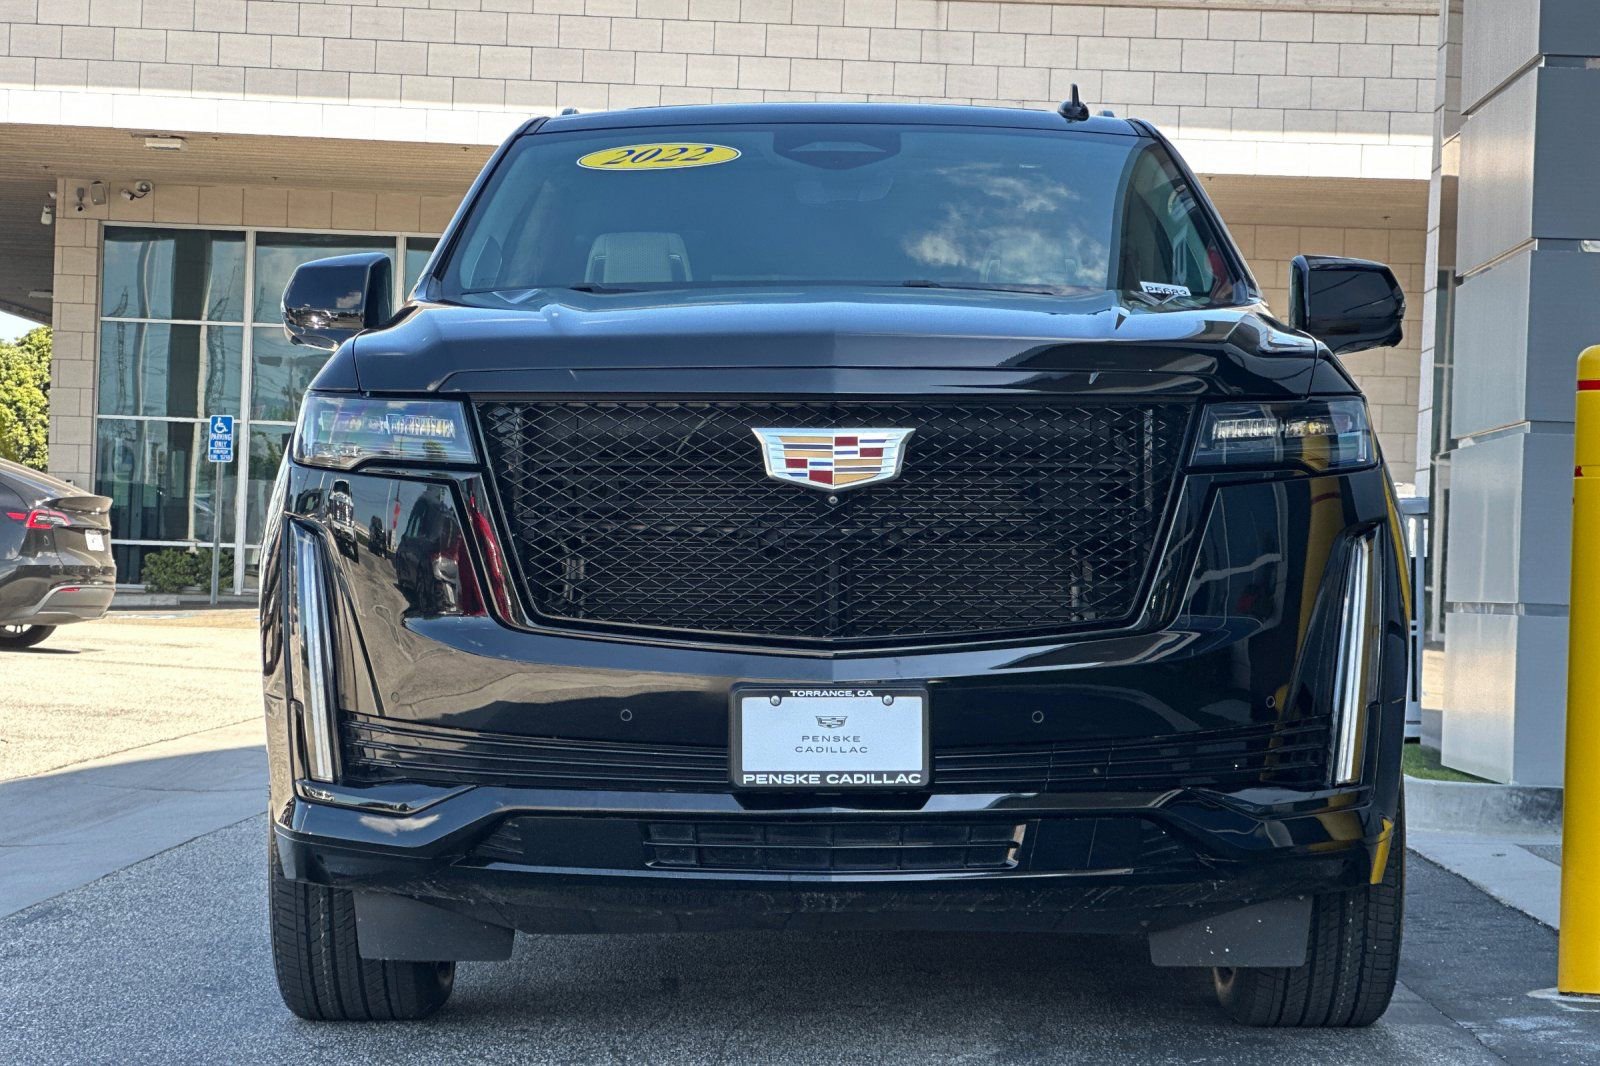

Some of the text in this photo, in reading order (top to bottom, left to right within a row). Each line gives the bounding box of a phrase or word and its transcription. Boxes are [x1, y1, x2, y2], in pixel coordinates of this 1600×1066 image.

[600, 147, 714, 165] 2022
[790, 690, 855, 698] TORRANCE,
[801, 735, 861, 743] PENSKE
[795, 746, 868, 754] CADILLAC
[743, 774, 921, 785] PENSKE CADILLAC
